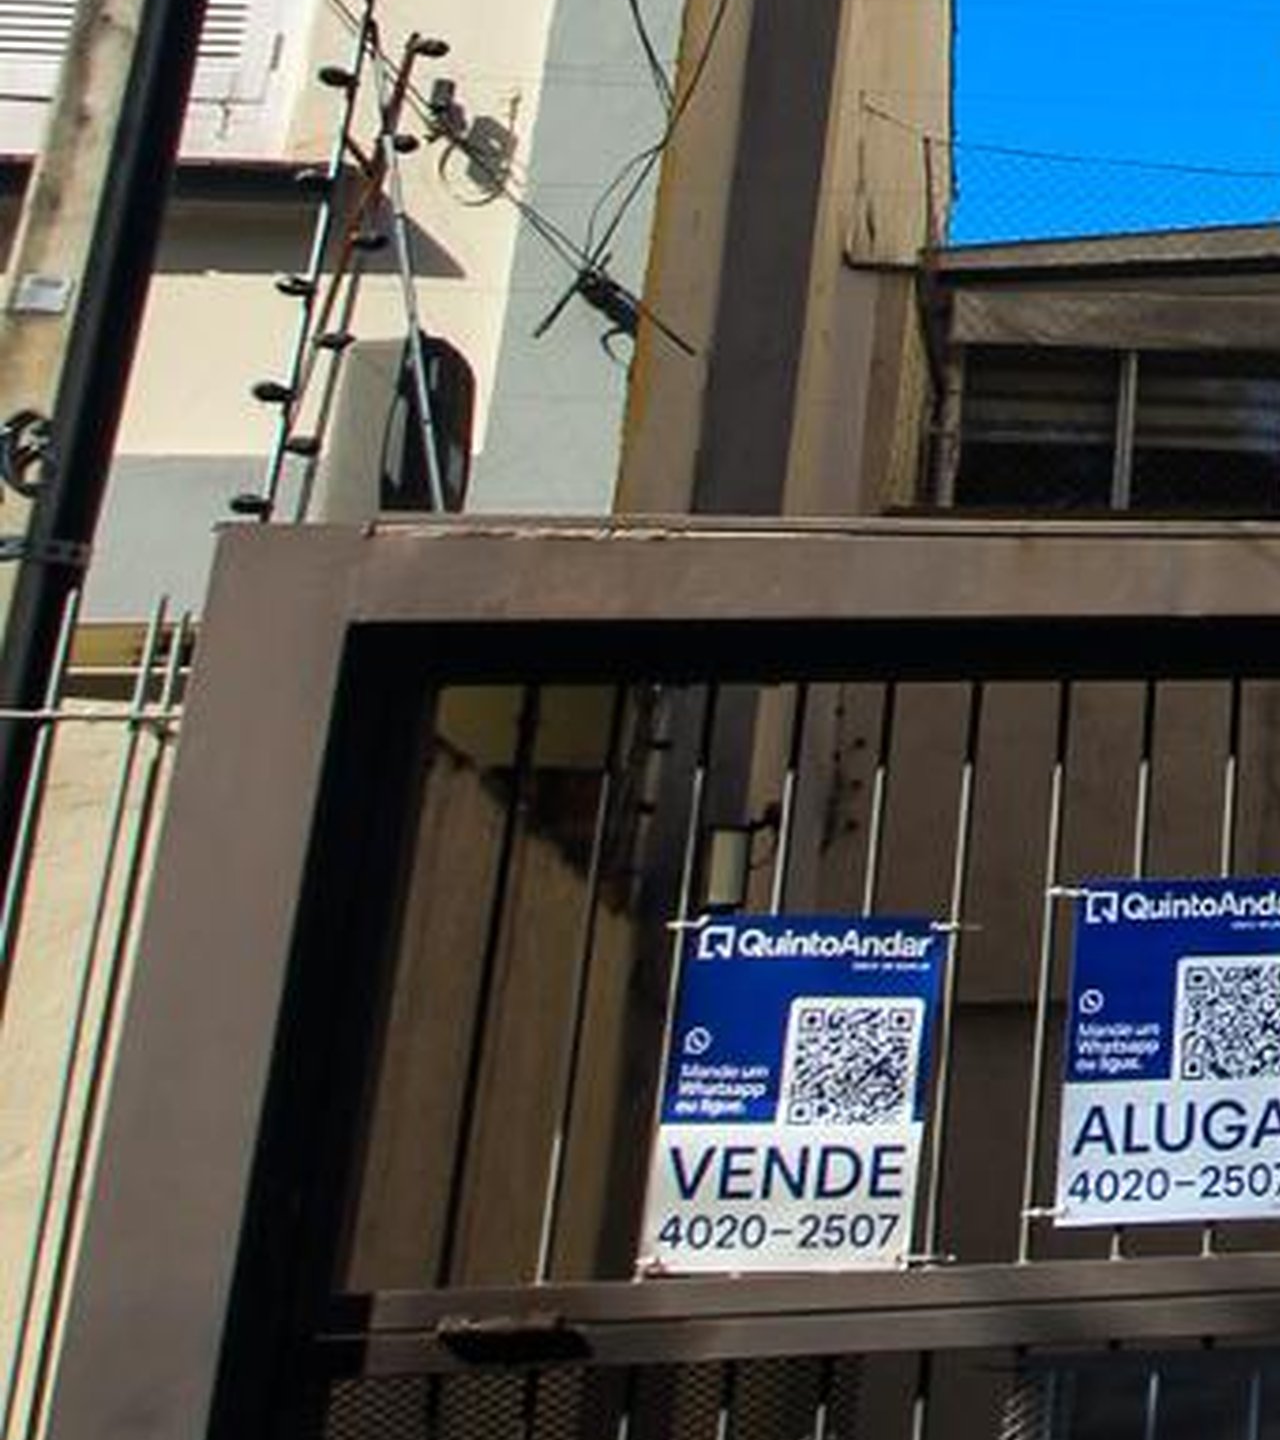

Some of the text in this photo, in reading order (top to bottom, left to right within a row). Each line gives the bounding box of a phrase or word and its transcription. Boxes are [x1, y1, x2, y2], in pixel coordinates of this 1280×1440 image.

[738, 928, 933, 959] QuintoAndar
[669, 1146, 907, 1200] VENDE
[658, 1213, 901, 1250] 4020-2507
